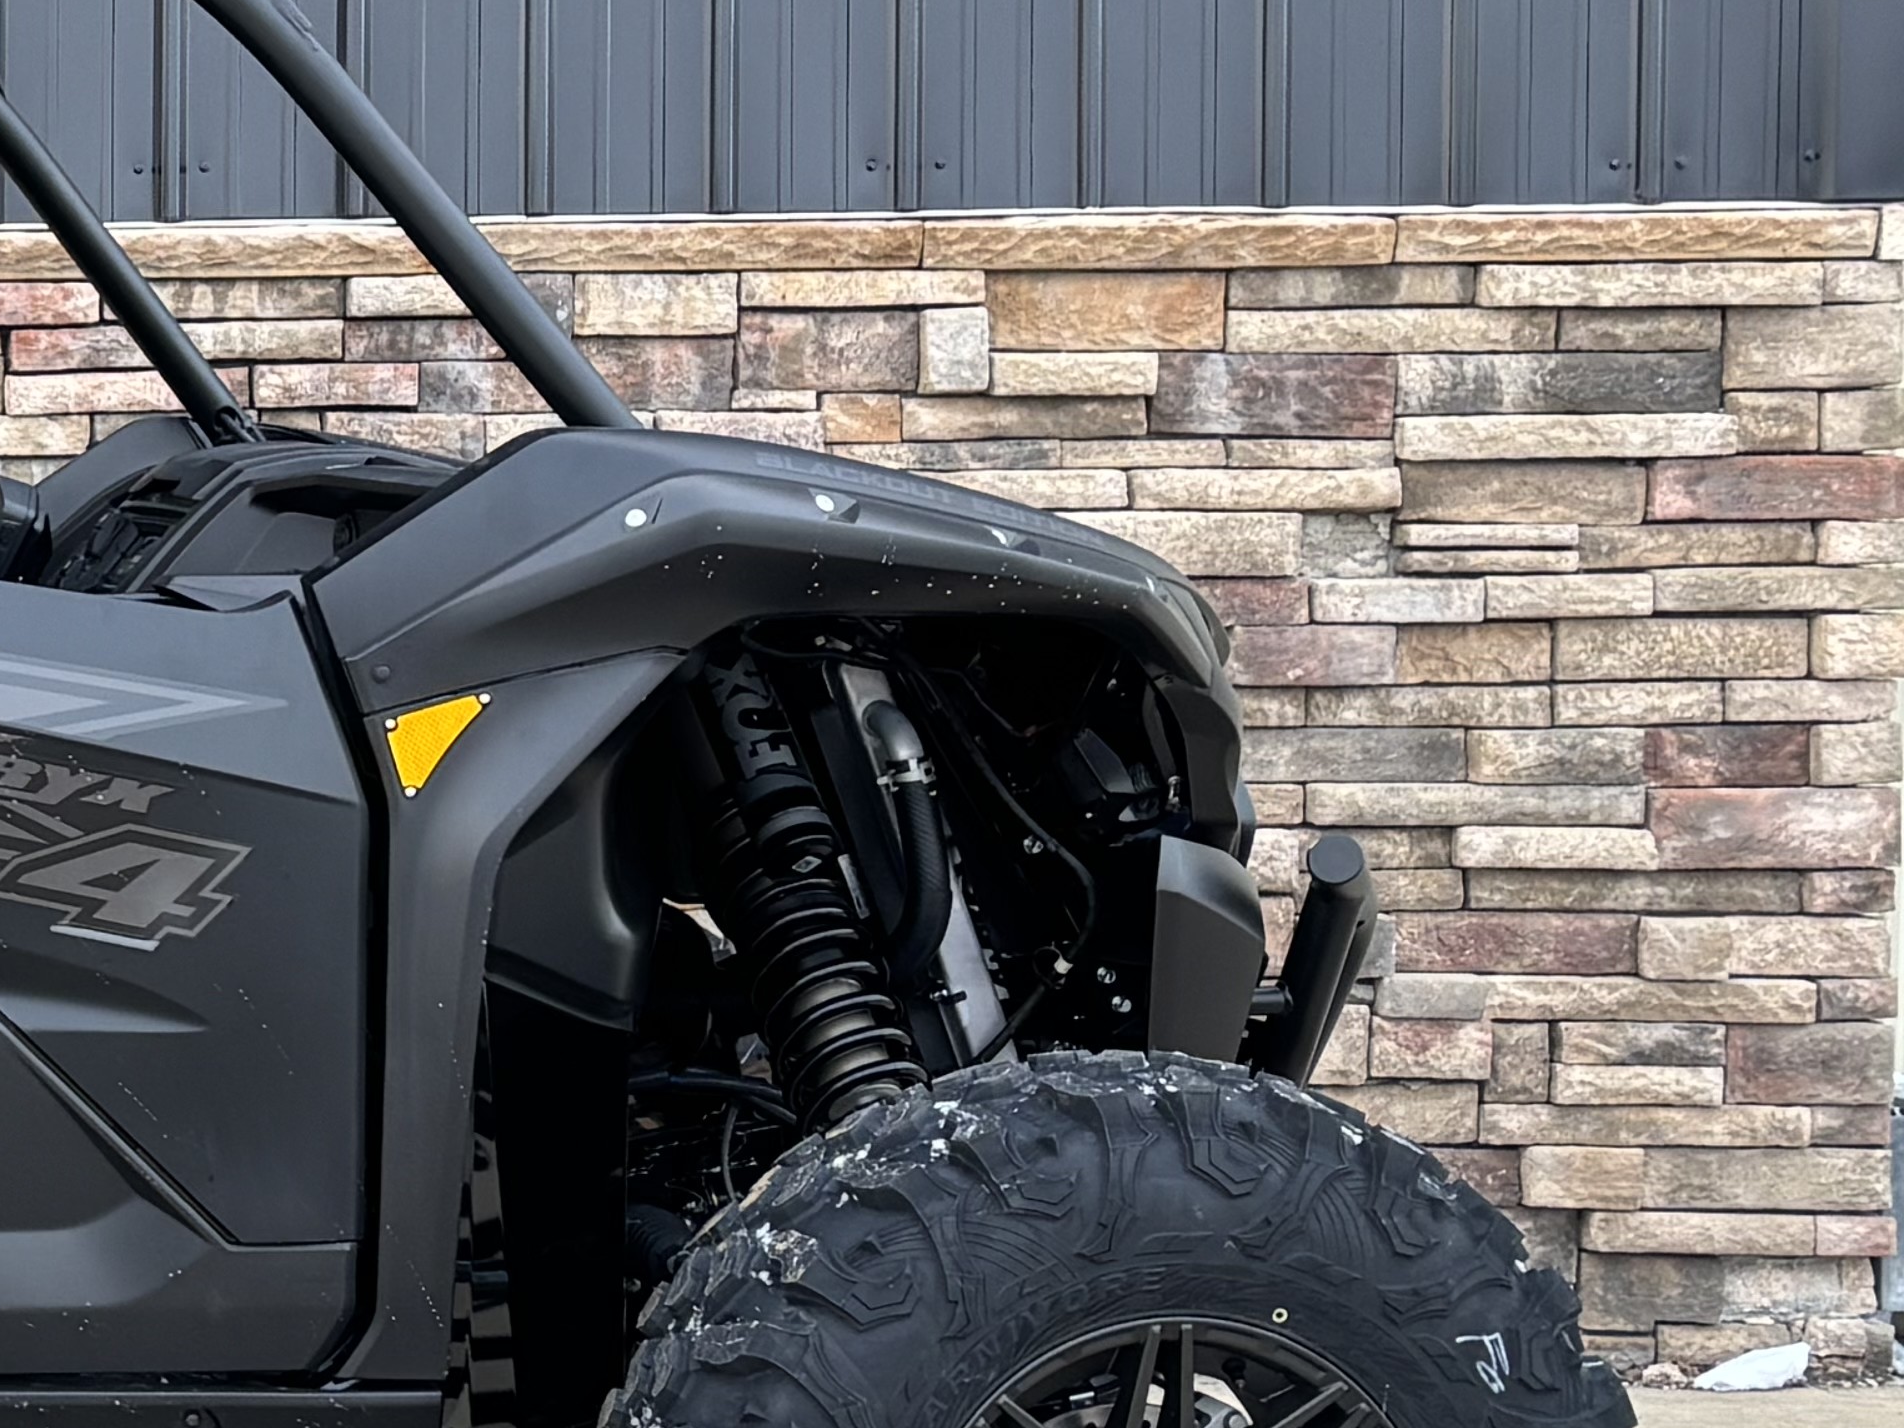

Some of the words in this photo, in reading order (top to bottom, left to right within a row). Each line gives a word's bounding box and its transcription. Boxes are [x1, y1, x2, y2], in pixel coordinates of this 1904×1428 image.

[755, 451, 951, 504] BLACKOUT
[972, 497, 1104, 546] EDITION
[703, 653, 796, 780] FOX
